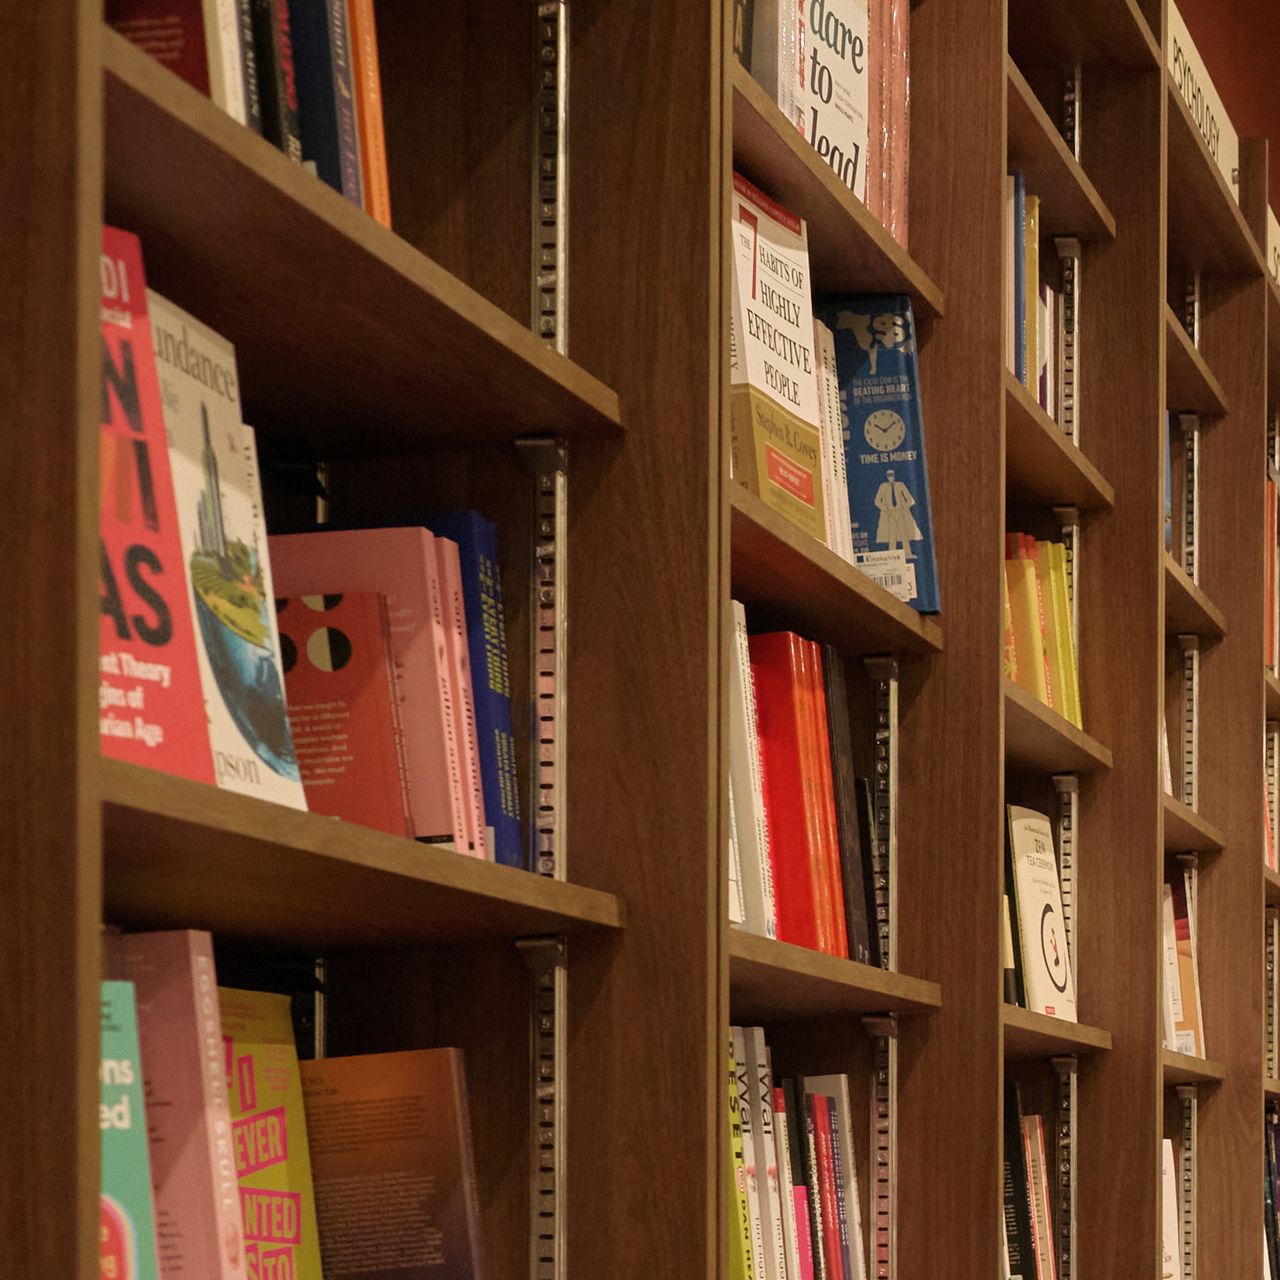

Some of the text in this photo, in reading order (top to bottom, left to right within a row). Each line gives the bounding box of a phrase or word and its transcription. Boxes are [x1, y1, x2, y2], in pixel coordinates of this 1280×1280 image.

[809, 0, 864, 74] dare
[810, 46, 833, 105] to
[1173, 36, 1220, 162] PSYCHOLOGY
[810, 106, 860, 190] lead
[739, 203, 758, 300] 7
[739, 233, 804, 290] THE HABITS OF
[760, 279, 801, 329] HIGHLY
[746, 307, 812, 375] EFFECTIVE
[763, 359, 801, 407] PEOPLE
[860, 450, 918, 465] TIME IS MONEY
[117, 651, 171, 689] Theory
[134, 715, 165, 748] Age
